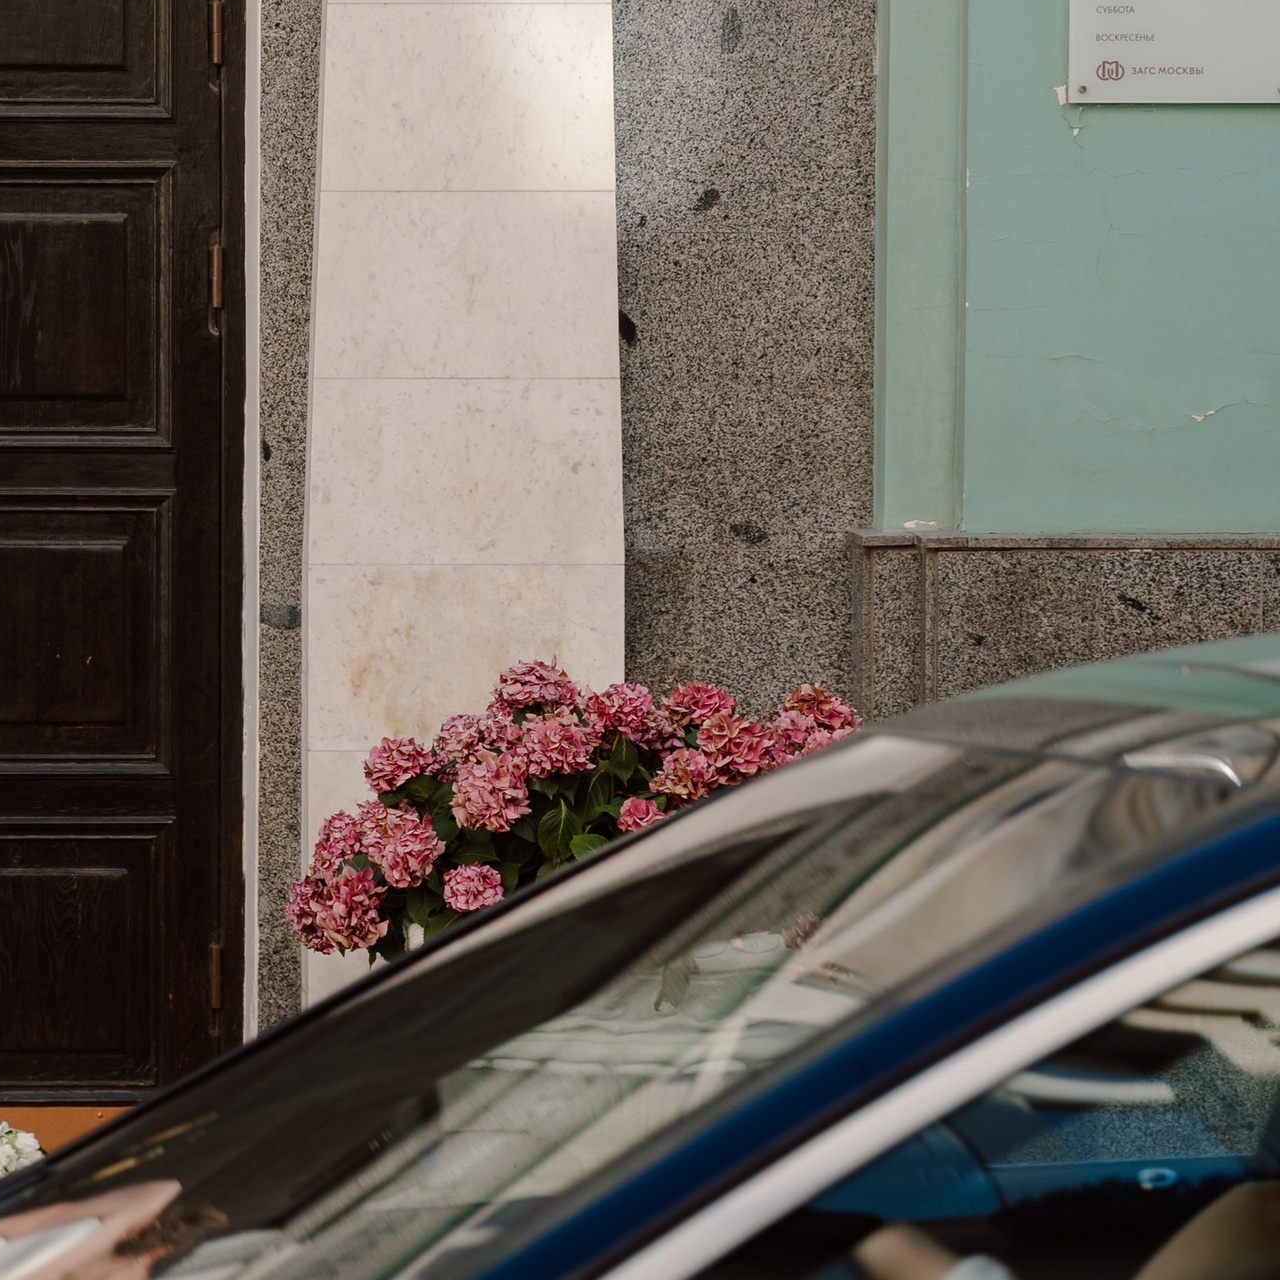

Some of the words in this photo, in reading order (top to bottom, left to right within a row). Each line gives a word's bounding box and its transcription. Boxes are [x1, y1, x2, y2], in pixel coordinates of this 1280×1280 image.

[1096, 6, 1135, 14] СУББОТА
[1095, 34, 1156, 42] ВОСКРЕСЕНЬЕ
[1131, 67, 1156, 75] ЗАГС
[1158, 67, 1204, 75] МОСКВЫ
